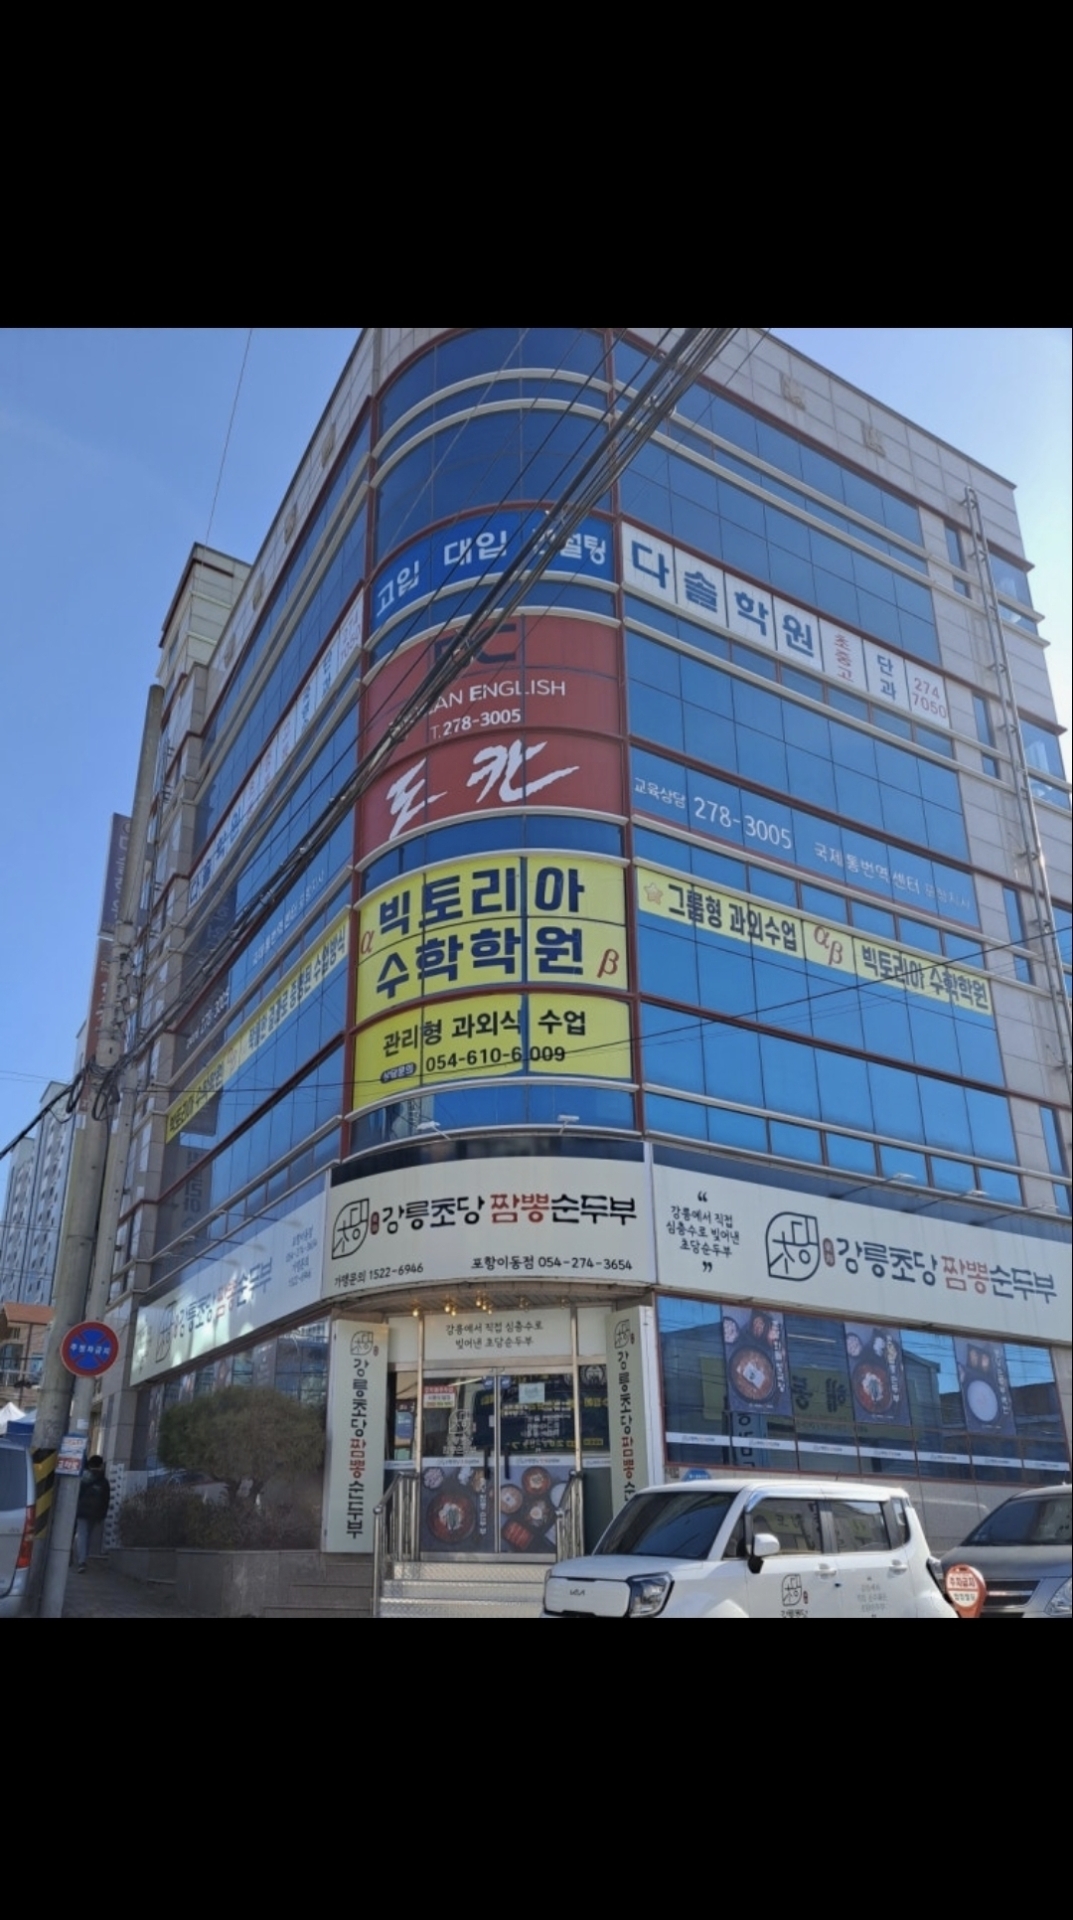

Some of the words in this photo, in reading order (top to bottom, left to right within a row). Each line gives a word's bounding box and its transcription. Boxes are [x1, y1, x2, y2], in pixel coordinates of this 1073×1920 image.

[376, 561, 420, 618] 고입
[443, 529, 507, 566] 대입
[631, 540, 815, 659] 다솔학원
[469, 679, 566, 703] ENGLISH
[914, 677, 941, 700] 274
[911, 692, 948, 719] 7050
[634, 776, 686, 809] 교육상담
[693, 797, 793, 850] 278-3005
[378, 866, 586, 937] 빅토리아
[667, 883, 722, 926] 그룹형
[728, 901, 798, 953] 과외수업
[375, 926, 584, 1000] 수학학원
[861, 943, 926, 991] 빅토리아
[929, 972, 990, 1010] 수학학원
[383, 1018, 443, 1059] 관리형
[451, 1009, 522, 1039] 과외식
[538, 1008, 587, 1037] 수업
[425, 1045, 566, 1073] 054-610-6009
[382, 1195, 486, 1235] 강릉초당
[666, 1220, 709, 1238] 심층수로
[671, 1205, 712, 1225] 강릉에서
[714, 1212, 733, 1229] 직접
[679, 1238, 733, 1259] 초당순두부
[836, 1237, 939, 1287] 강릉초당
[369, 1262, 424, 1280] 1522-6946
[471, 1255, 535, 1271] 포항이동점
[538, 1255, 633, 1272] 054-274-3654
[445, 1322, 483, 1336] 강릉에서
[485, 1321, 503, 1334] 직접
[505, 1320, 544, 1333] 심층수로
[484, 1336, 535, 1349] 초당순두부
